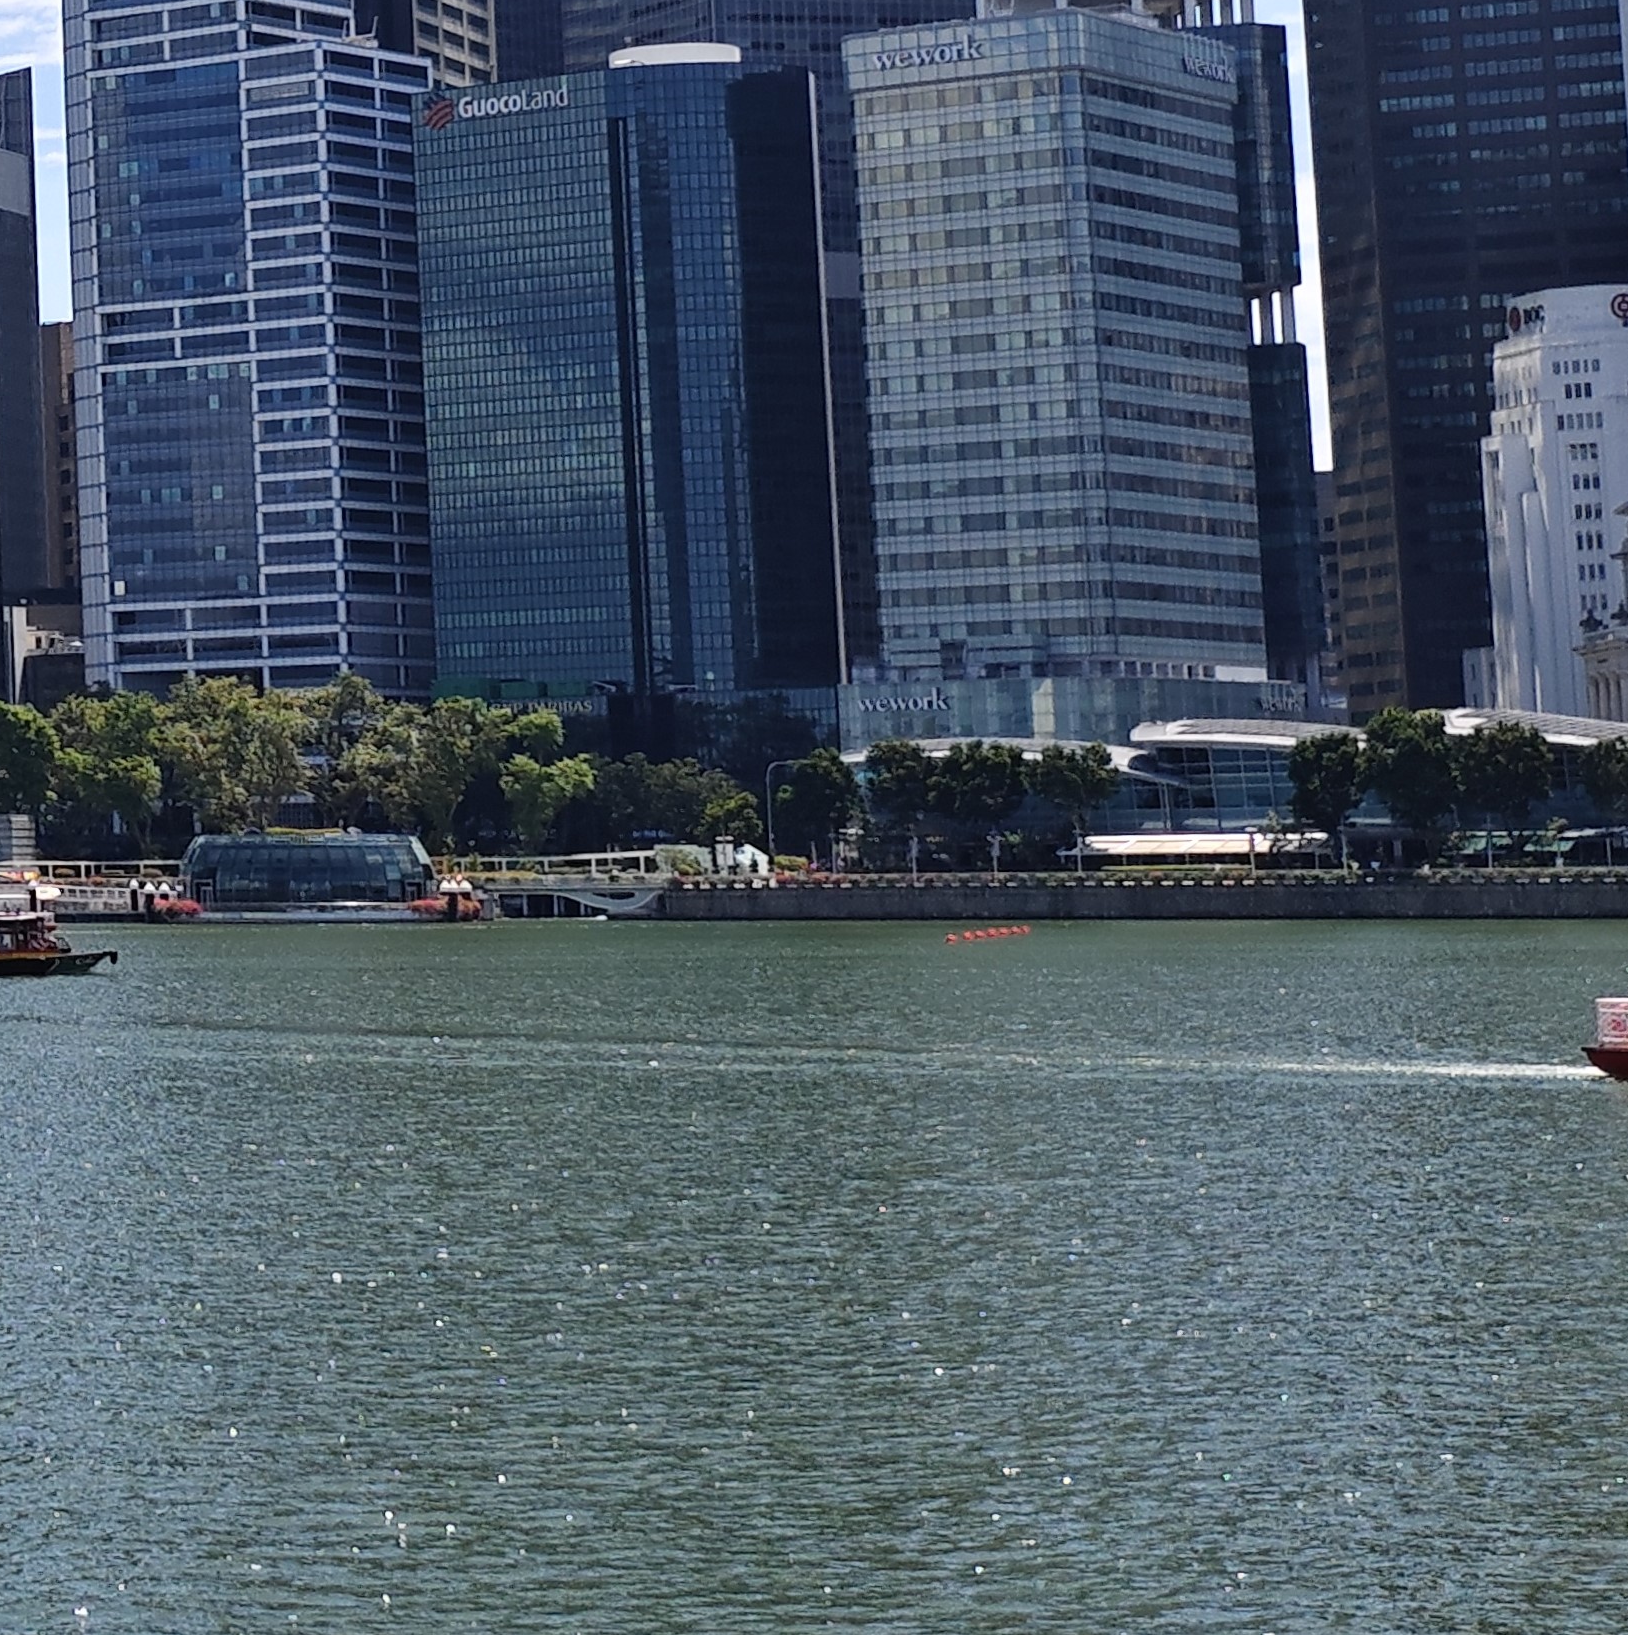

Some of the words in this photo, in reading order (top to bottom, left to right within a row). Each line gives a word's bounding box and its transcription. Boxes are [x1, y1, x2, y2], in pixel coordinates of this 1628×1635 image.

[874, 34, 982, 70] wework
[1523, 304, 1545, 325] BOC
[858, 687, 949, 712] wework
